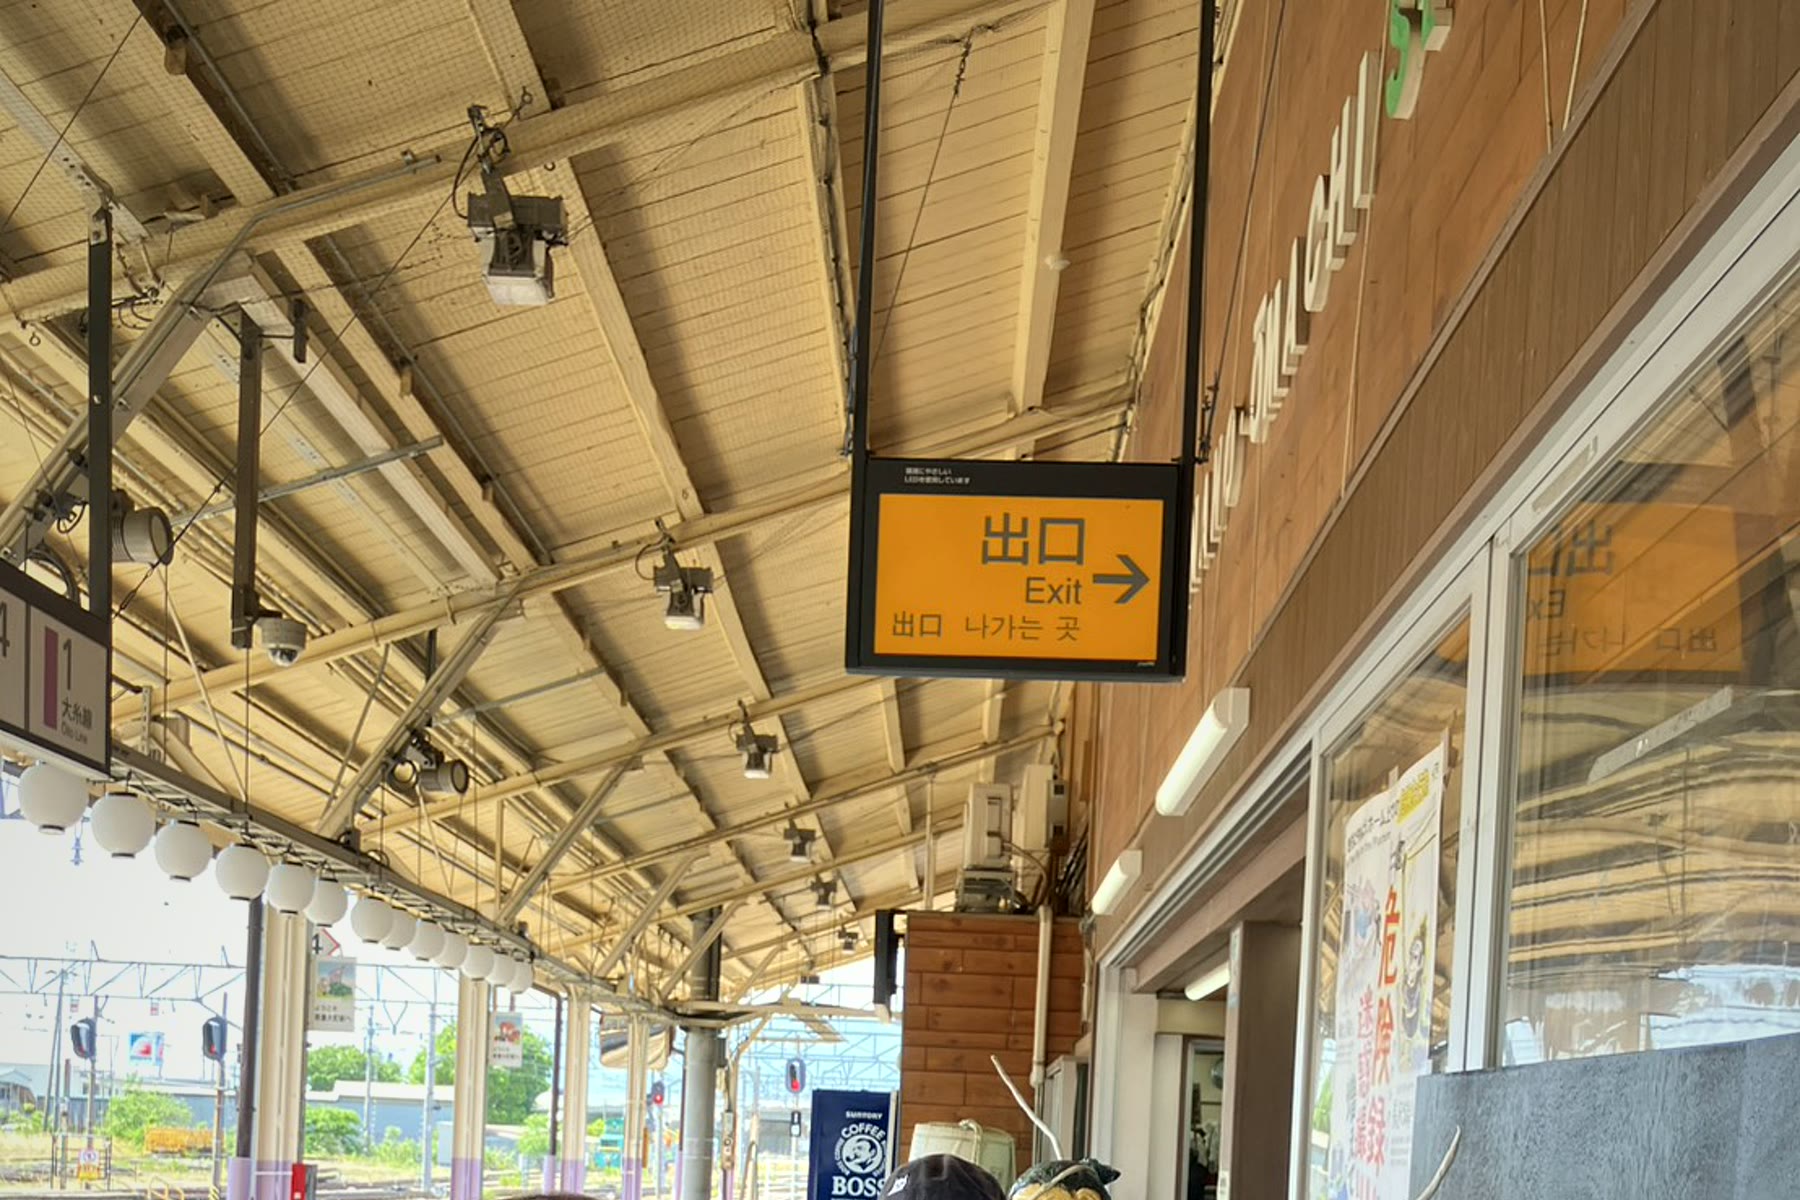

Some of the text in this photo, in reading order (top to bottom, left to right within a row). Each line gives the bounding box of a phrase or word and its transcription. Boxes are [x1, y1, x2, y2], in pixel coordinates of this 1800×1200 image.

[981, 512, 1085, 565] 出口
[1025, 576, 1082, 605] Exit
[892, 610, 943, 638] 出口
[965, 613, 1080, 641] 나가는 곳
[62, 638, 72, 691] 1
[841, 1122, 886, 1140] COFFEE
